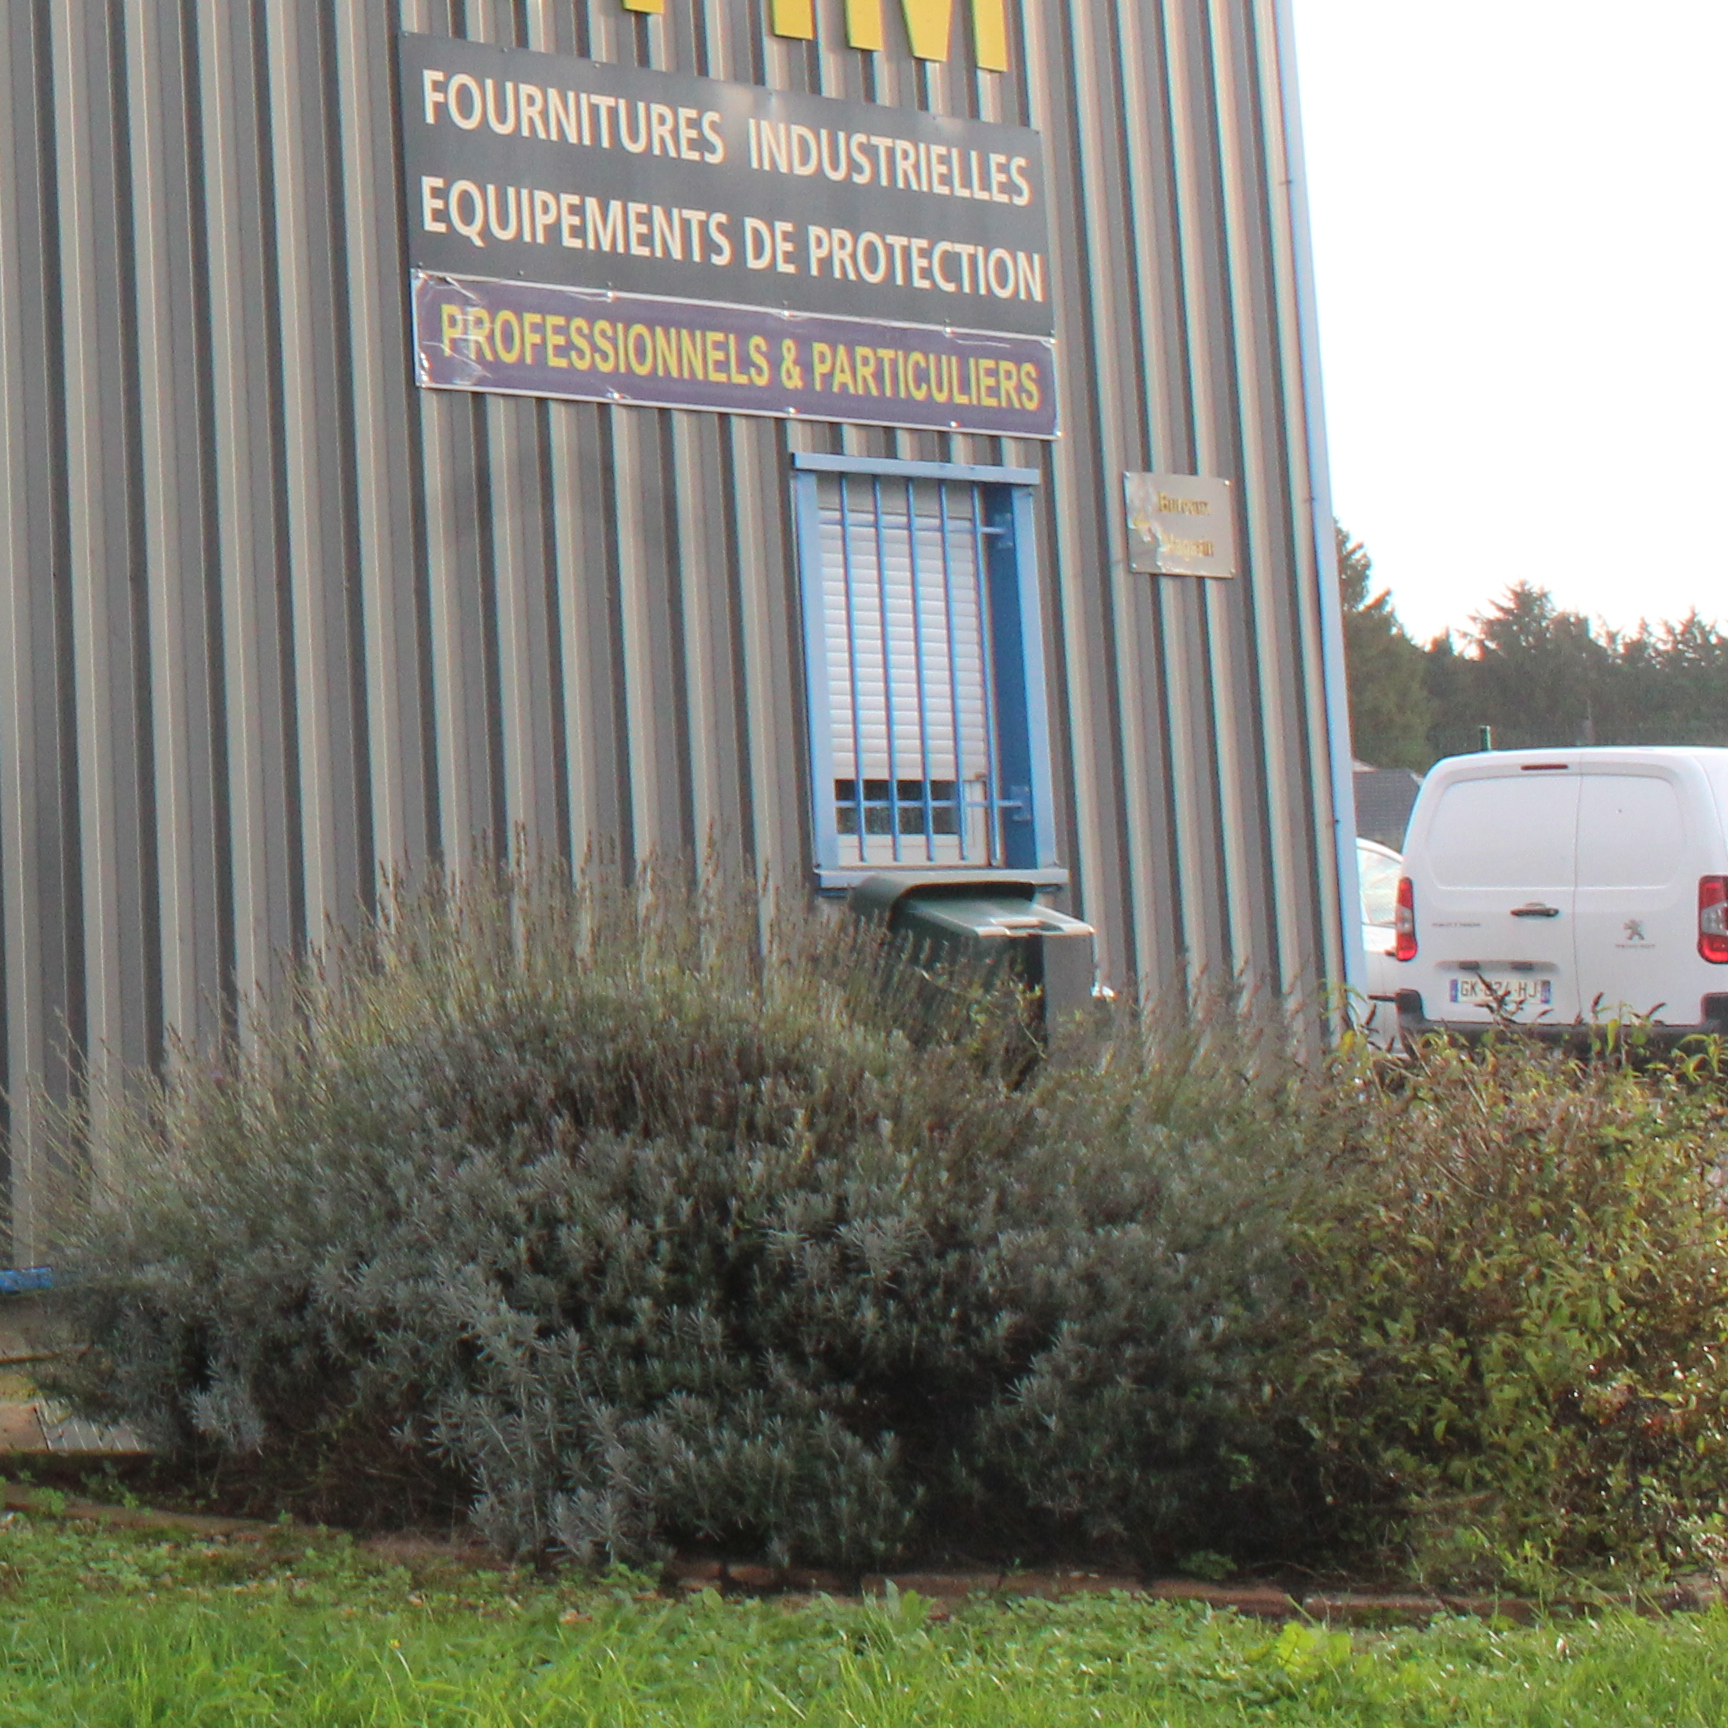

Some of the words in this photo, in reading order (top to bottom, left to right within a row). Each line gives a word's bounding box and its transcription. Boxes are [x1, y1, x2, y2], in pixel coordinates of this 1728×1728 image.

[423, 68, 725, 165] FOURNITURES
[748, 116, 1032, 208] INDUSTRIELLES
[421, 174, 732, 268] EQUIPEMENTS
[744, 216, 796, 275] DE
[808, 225, 1043, 303] PROTECTION
[440, 302, 769, 388] PROFESSIONNELS
[781, 337, 804, 390] &
[812, 341, 1040, 412] PARTICULIERS
